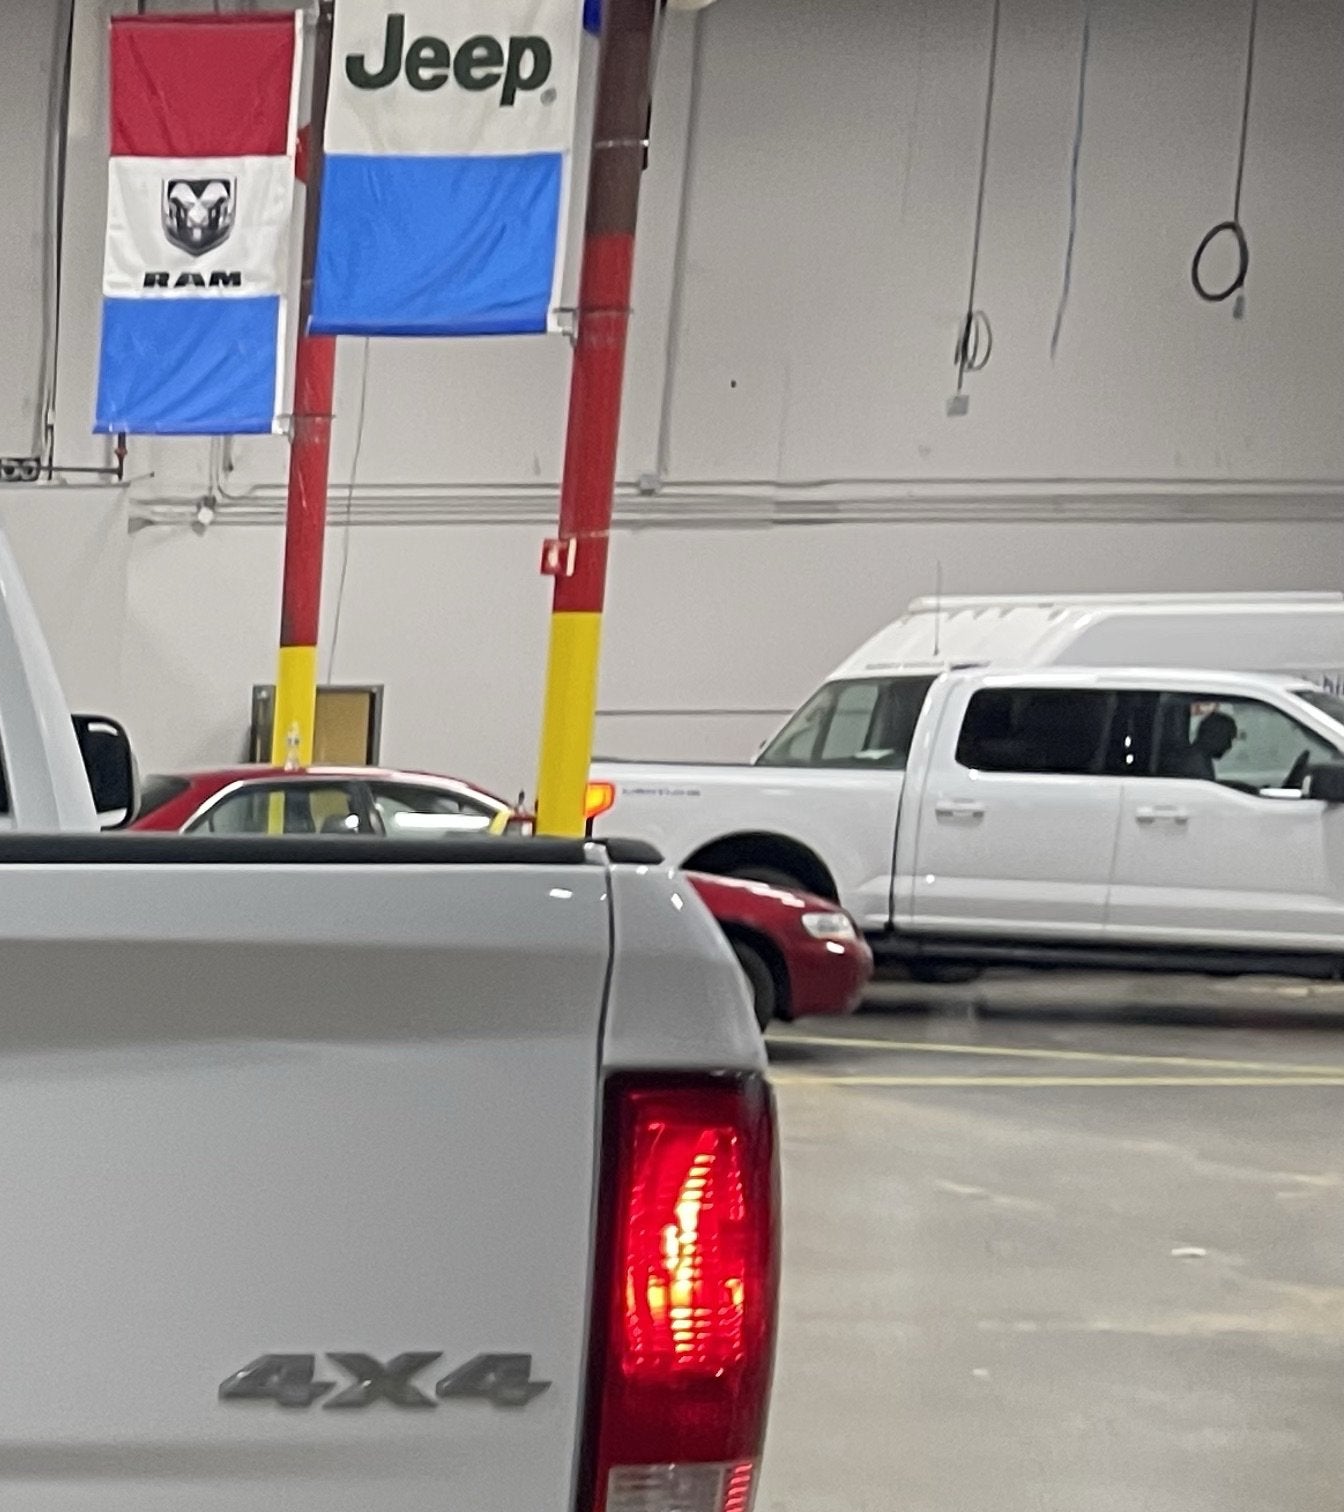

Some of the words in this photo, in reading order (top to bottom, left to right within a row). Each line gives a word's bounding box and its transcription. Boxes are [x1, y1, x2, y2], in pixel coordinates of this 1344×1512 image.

[344, 13, 552, 107] Jeep
[142, 270, 241, 288] RAM
[218, 1350, 553, 1412] 4X4
